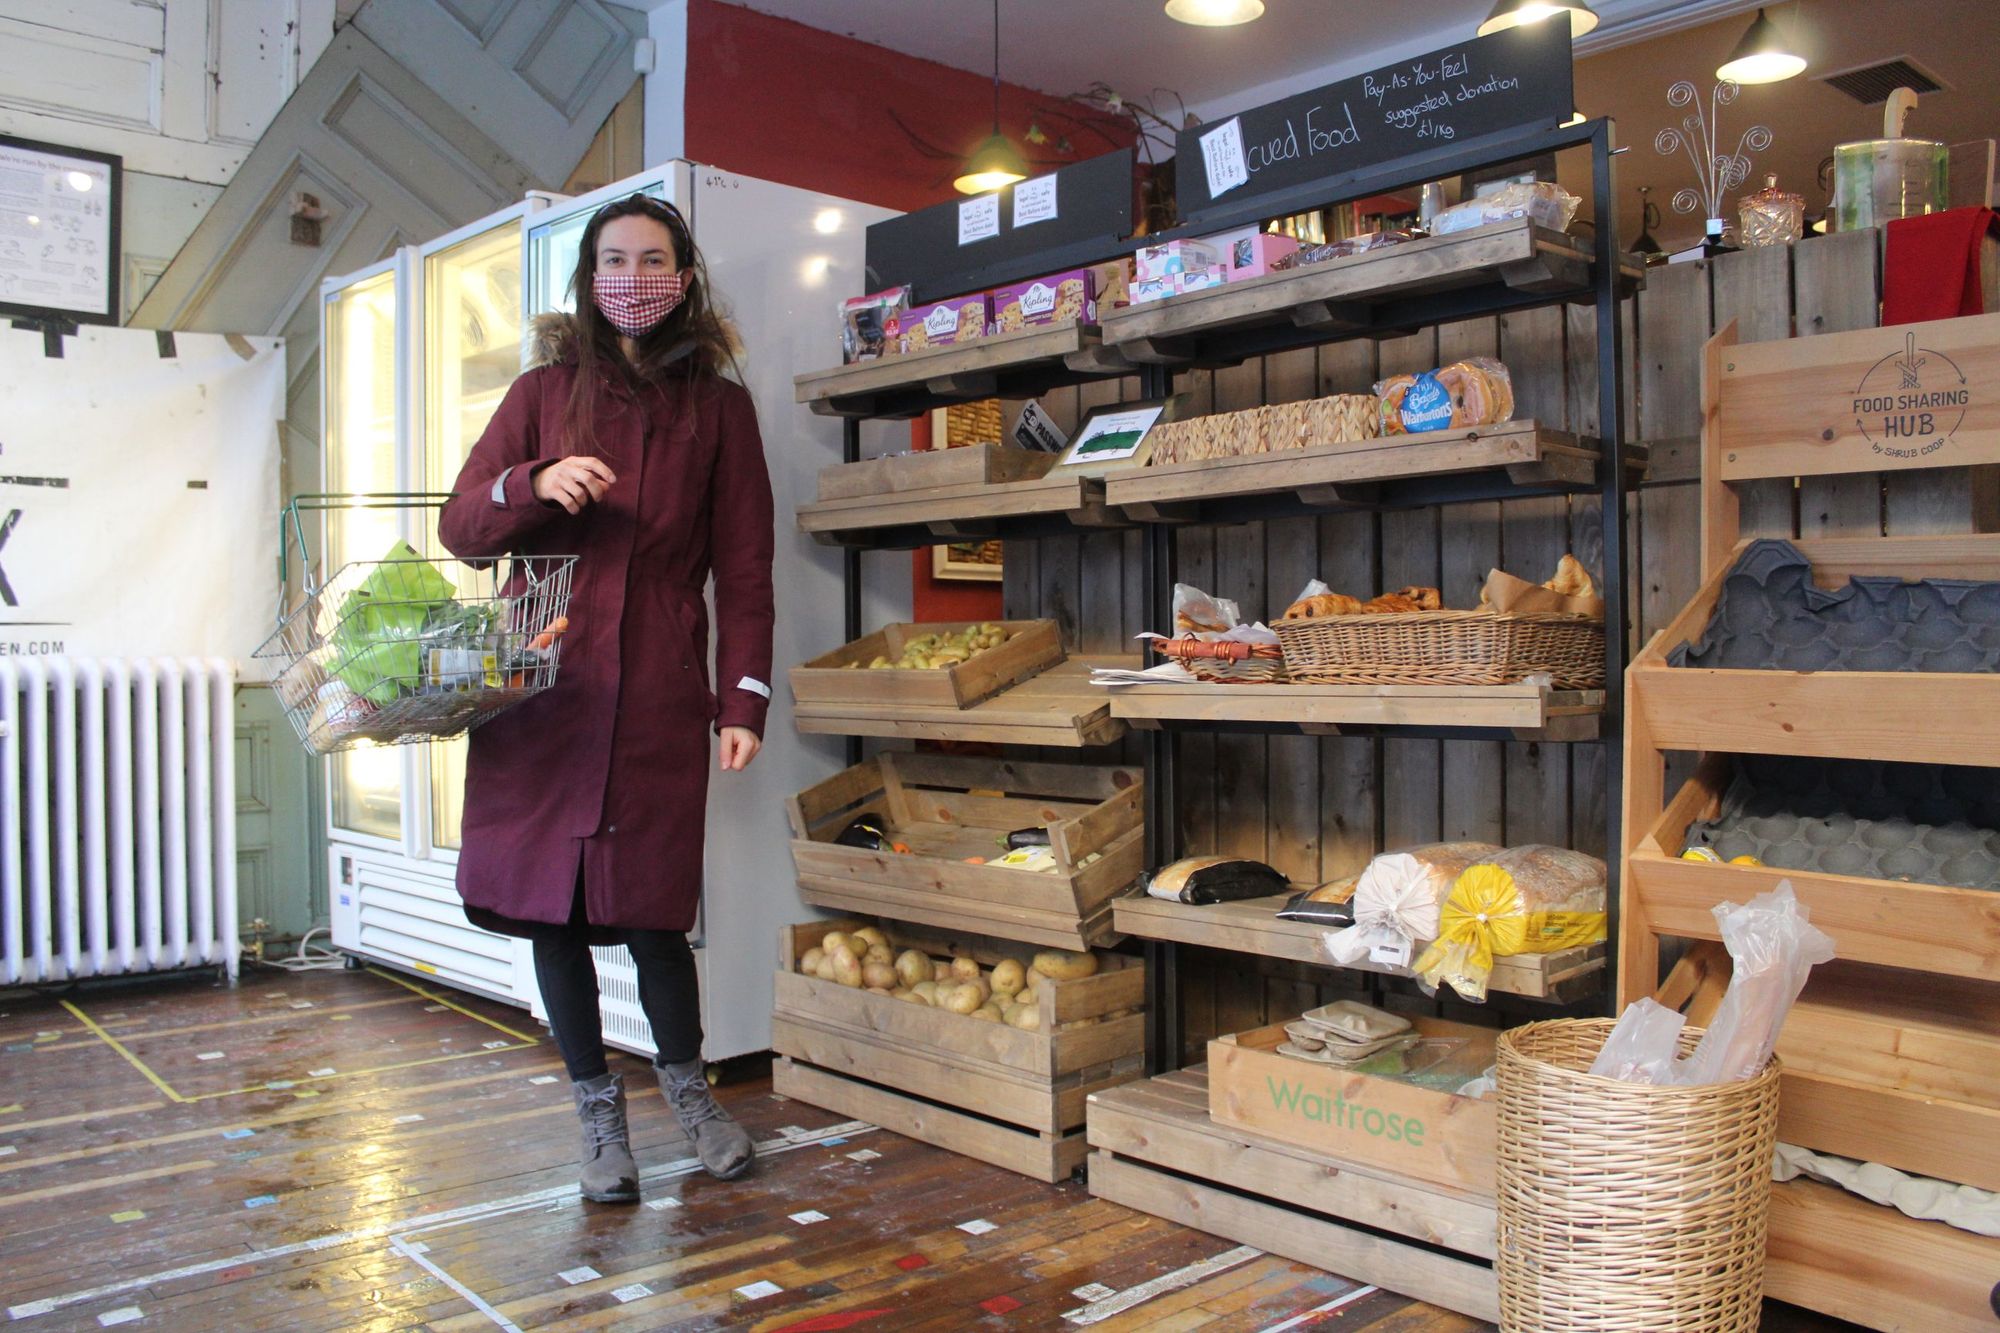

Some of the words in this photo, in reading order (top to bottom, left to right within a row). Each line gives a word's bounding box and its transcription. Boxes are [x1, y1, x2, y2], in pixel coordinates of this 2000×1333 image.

[1364, 53, 1469, 106] Pay-As-You-Feel
[1384, 91, 1451, 129] suggested
[1456, 76, 1519, 101] donation
[1247, 120, 1300, 173] cued
[1306, 102, 1360, 156] Food
[1022, 292, 1053, 310] Kipling
[928, 313, 956, 330] Kipling
[1401, 402, 1452, 425] Warburtons
[1853, 396, 1893, 413] FOOD
[1898, 390, 1969, 410] SHARING
[1884, 413, 1934, 438] HUB
[1035, 422, 1061, 454] PASSW
[1872, 442, 1882, 454] by
[1884, 447, 1918, 458] SHRUB
[1921, 438, 1945, 455] COOP
[0, 641, 65, 656] EN.COM
[1265, 1075, 1425, 1147] Waitrose
